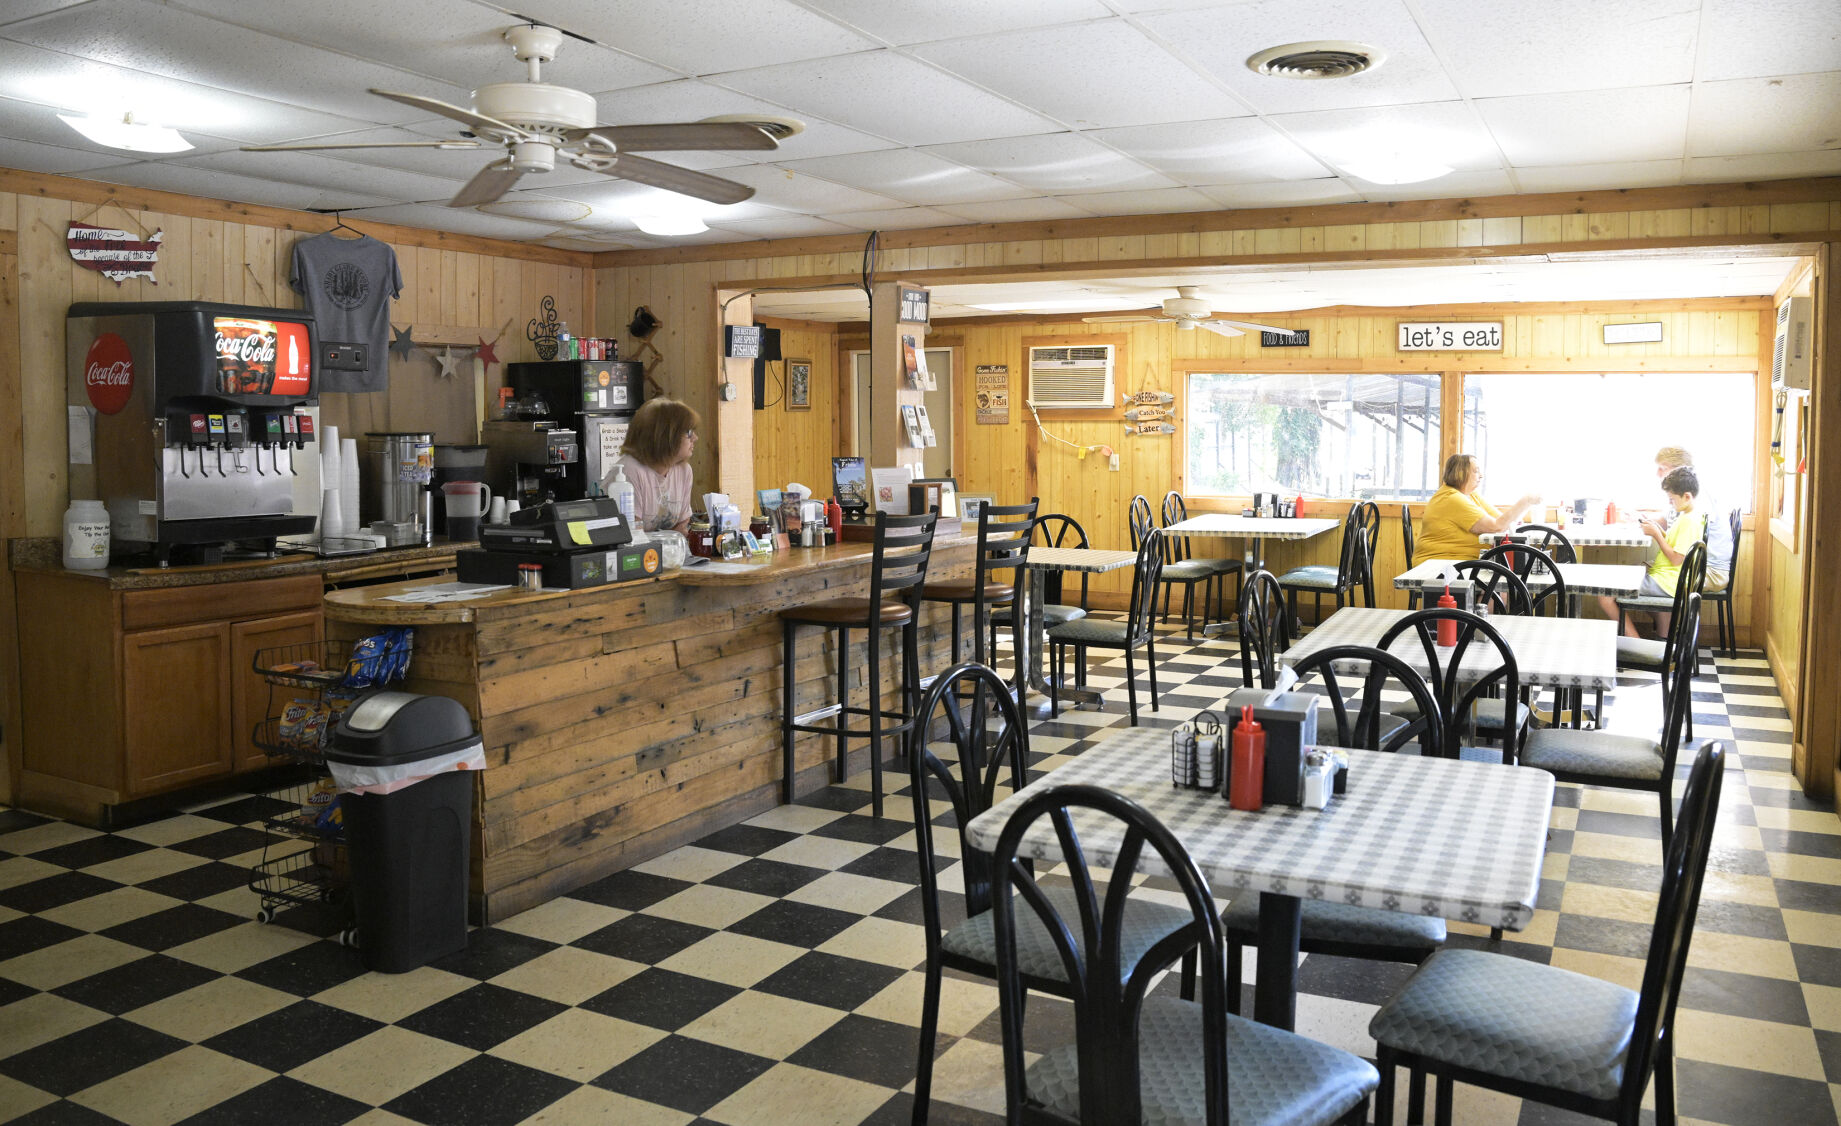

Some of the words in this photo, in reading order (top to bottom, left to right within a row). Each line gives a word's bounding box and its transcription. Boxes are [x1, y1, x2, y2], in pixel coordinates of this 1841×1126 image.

[74, 229, 104, 242] Home
[123, 250, 132, 261] of
[132, 250, 144, 260] the
[734, 335, 743, 344] ARE
[743, 336, 758, 345] SPENT
[1402, 325, 1454, 347] let's
[1462, 326, 1500, 347] eat
[733, 344, 757, 356] FISHING
[87, 361, 132, 386] Coca-Cola
[978, 375, 1006, 384] HOOKED
[992, 398, 1007, 406] FISH
[1138, 425, 1160, 433] Later
